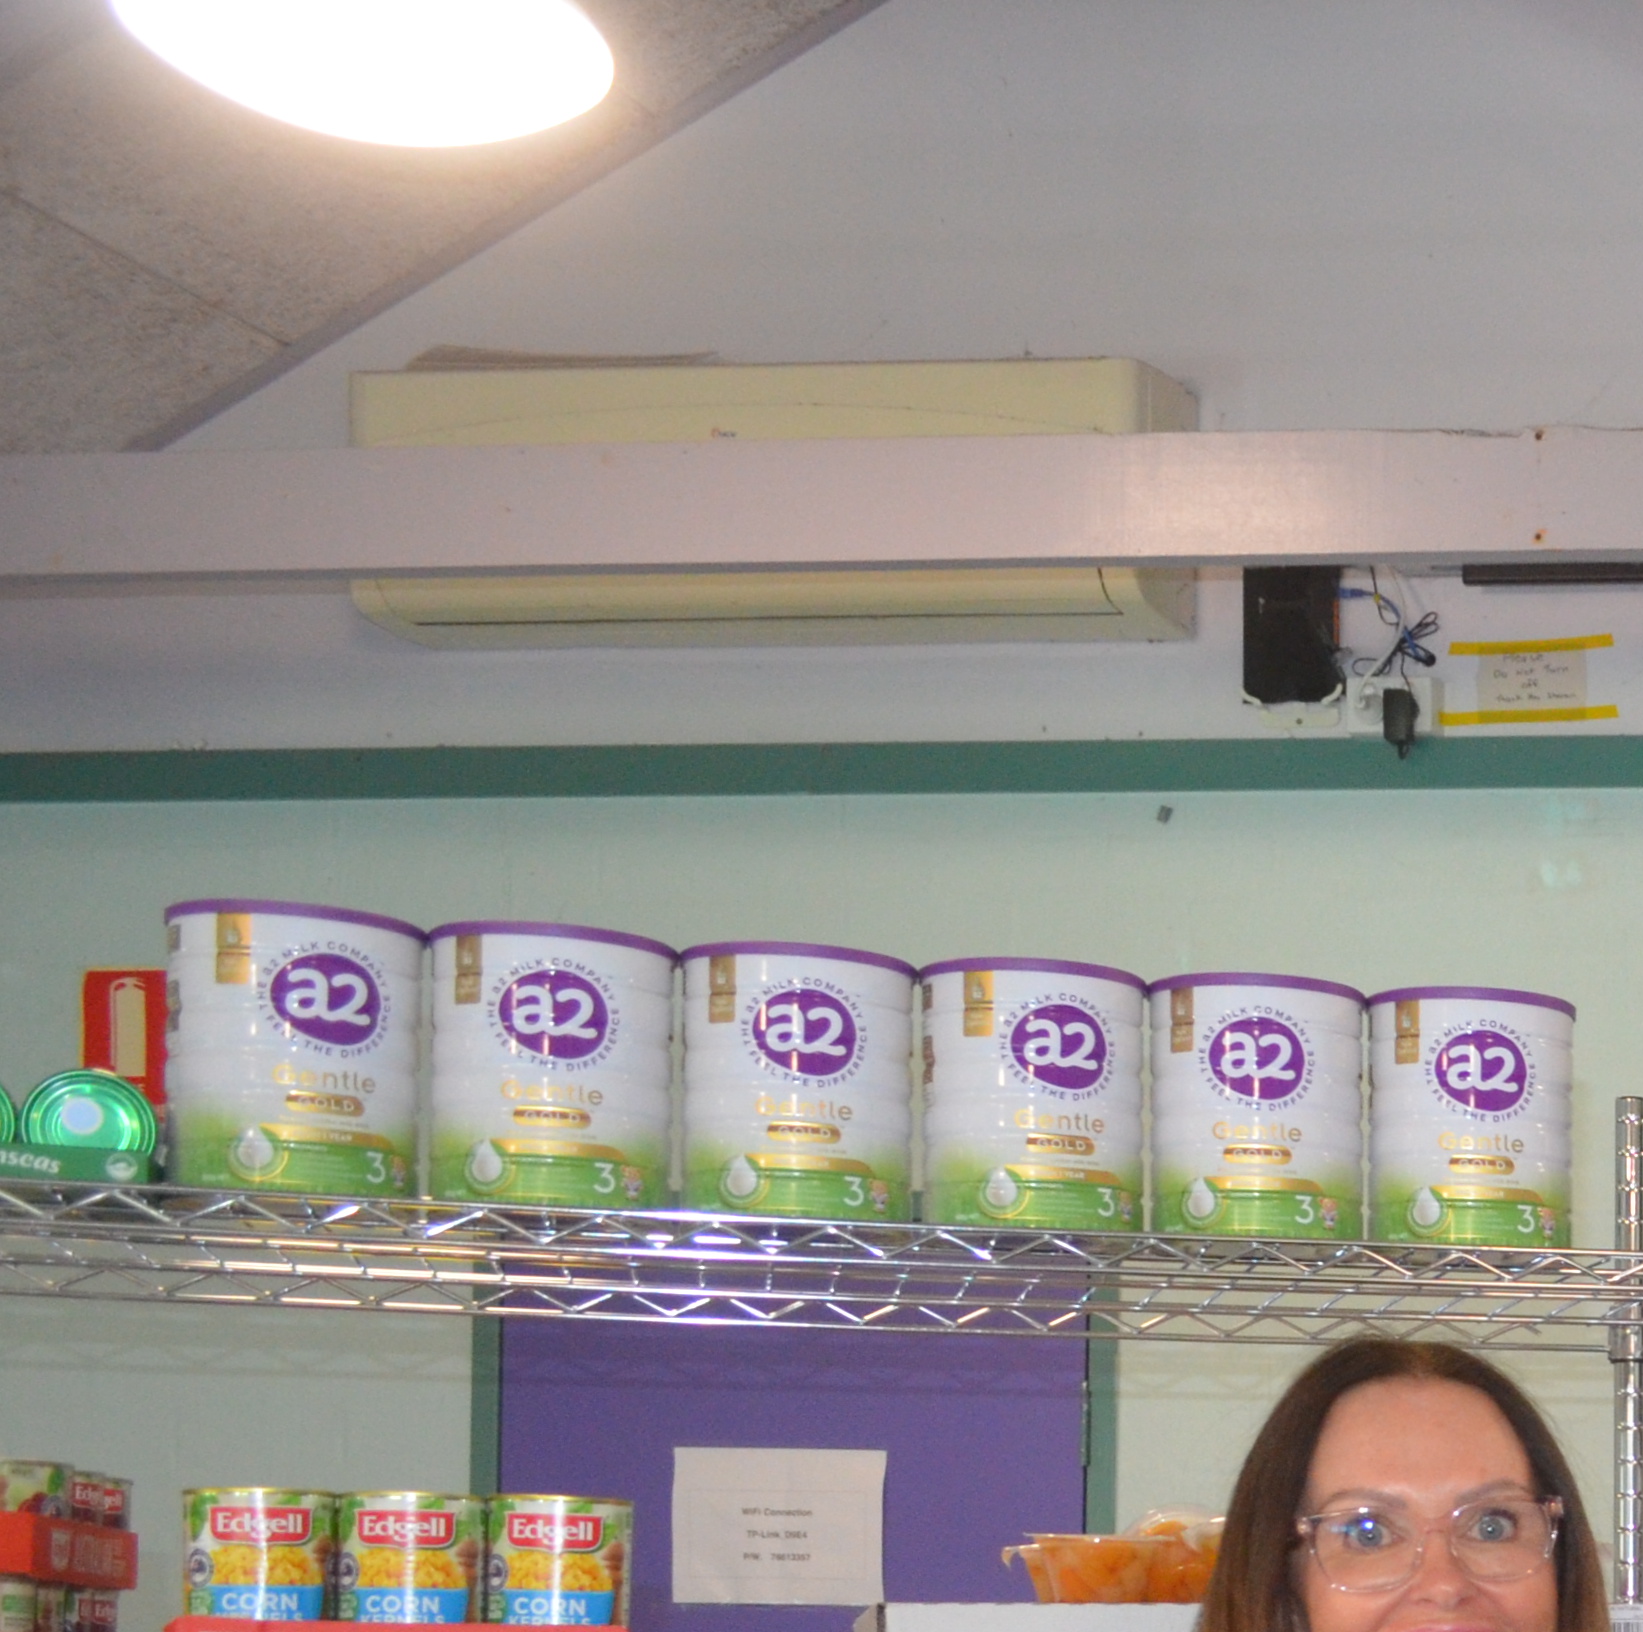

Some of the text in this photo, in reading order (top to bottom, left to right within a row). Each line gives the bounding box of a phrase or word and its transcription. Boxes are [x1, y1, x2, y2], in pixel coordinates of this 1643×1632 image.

[285, 968, 371, 1026] a2
[512, 985, 598, 1039] a2
[1024, 1019, 1098, 1070] a2
[1443, 1044, 1520, 1095] a2
[217, 1512, 303, 1539] Edgell
[363, 1514, 446, 1541] Edgell
[221, 1592, 299, 1611] CORN
[365, 1593, 439, 1614] CORN
